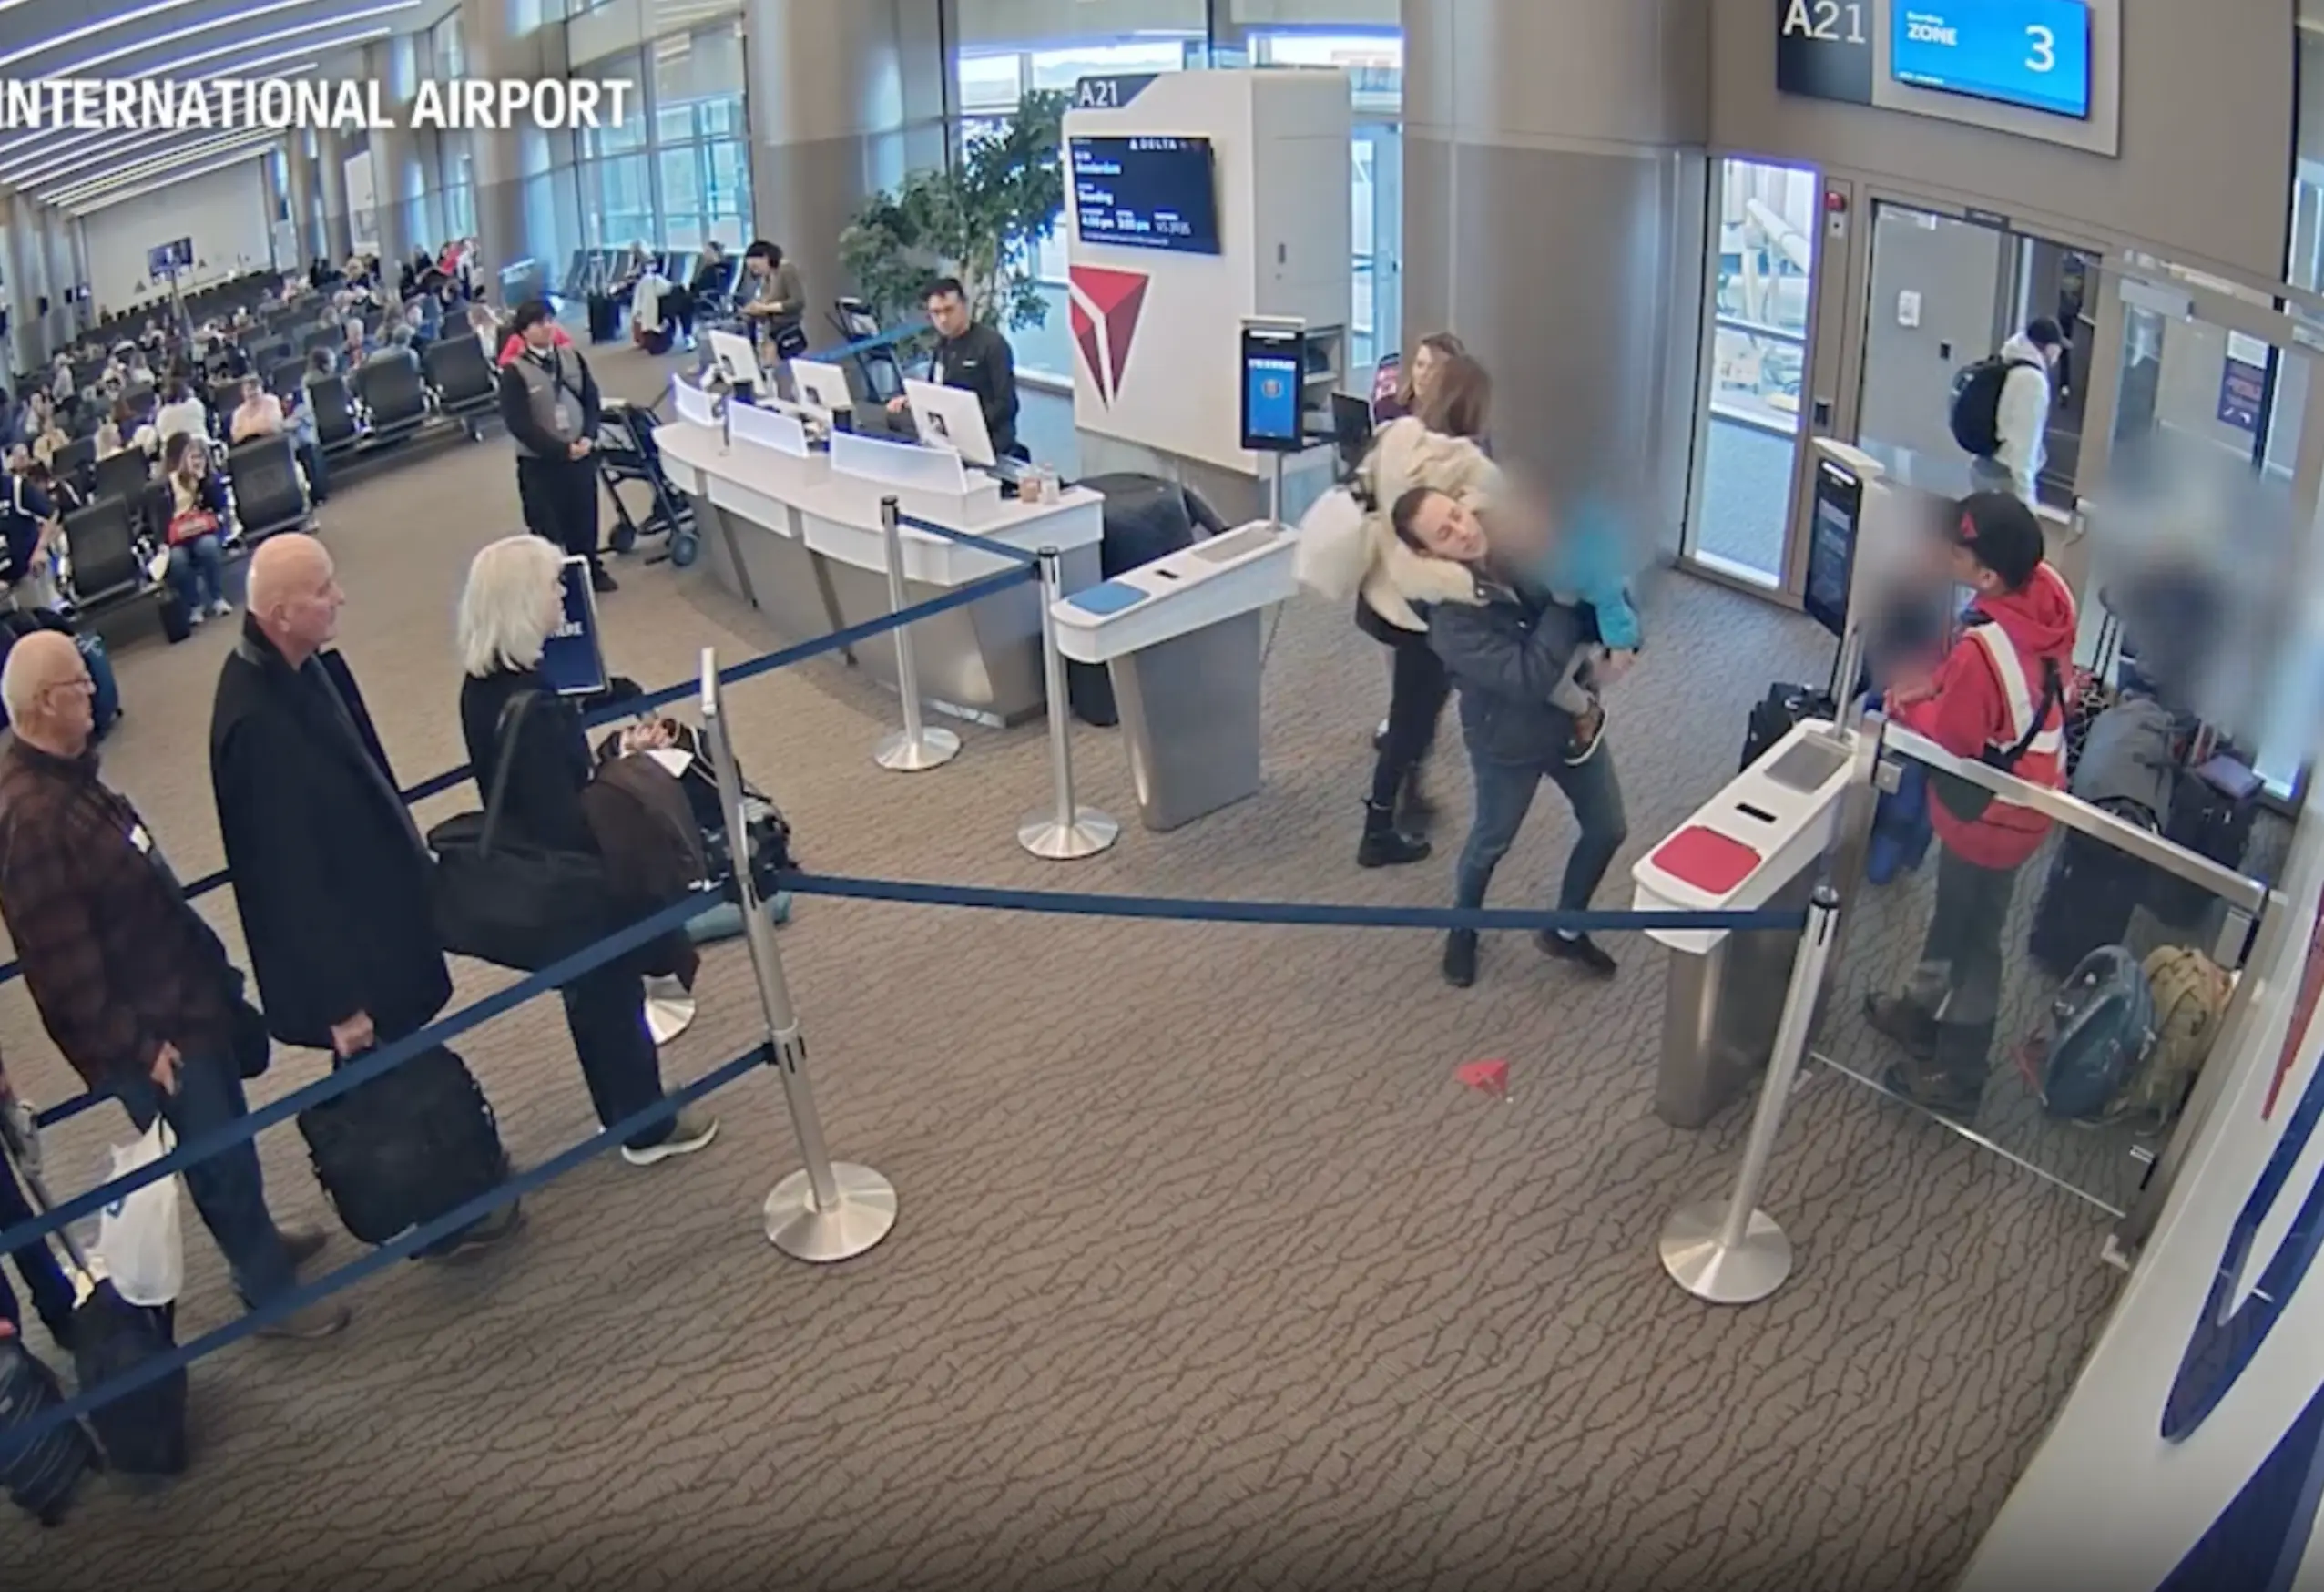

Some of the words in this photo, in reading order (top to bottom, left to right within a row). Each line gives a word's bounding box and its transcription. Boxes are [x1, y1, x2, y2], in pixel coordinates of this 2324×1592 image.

[1782, 0, 1866, 44] A21
[1908, 23, 1958, 46] ZONE
[2024, 25, 2055, 73] 3
[1079, 81, 1117, 107] A21
